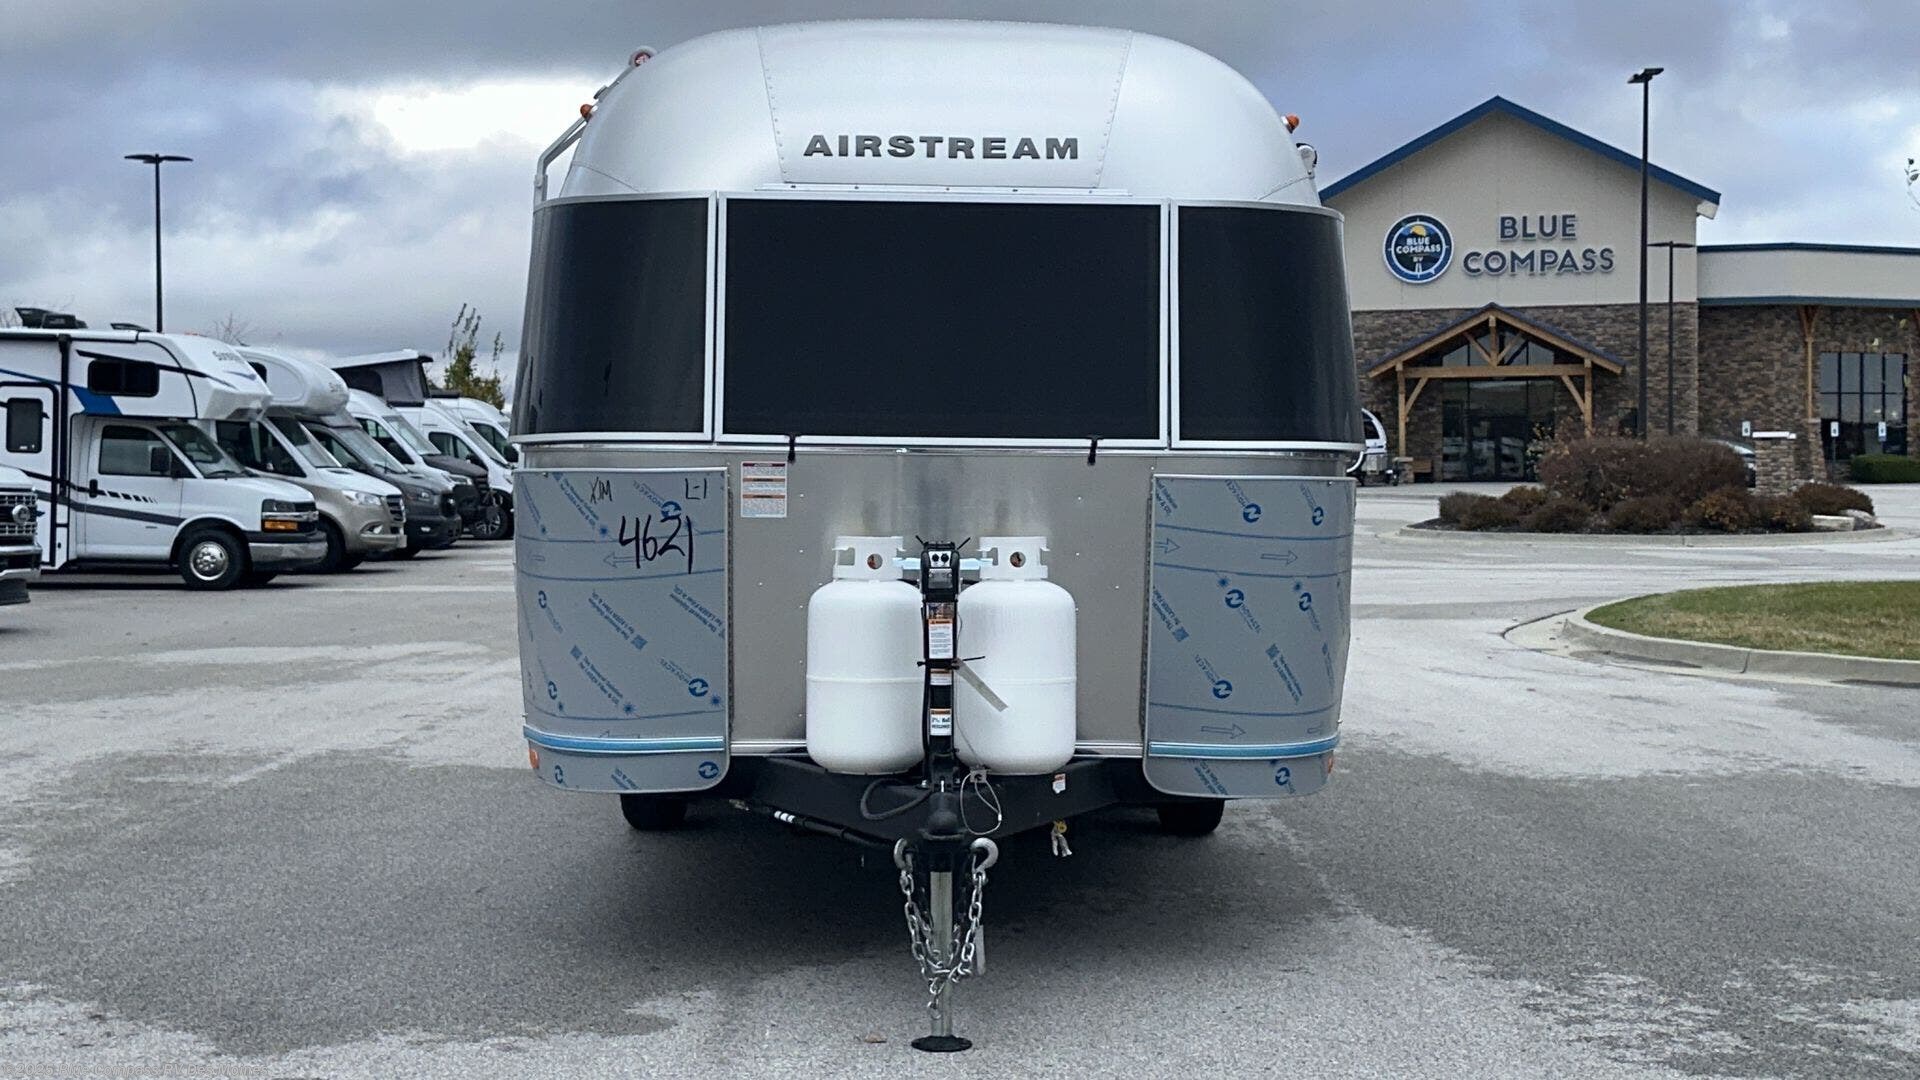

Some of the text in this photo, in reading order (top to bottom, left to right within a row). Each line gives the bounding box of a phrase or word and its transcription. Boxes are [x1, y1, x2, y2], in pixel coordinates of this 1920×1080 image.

[803, 134, 1078, 160] AIRSTREAM
[1500, 214, 1576, 239] BLUE
[1395, 244, 1441, 254] COMPASS
[1406, 237, 1430, 245] BLUE
[1464, 247, 1614, 273] COMPASS
[618, 514, 694, 574] 4621
